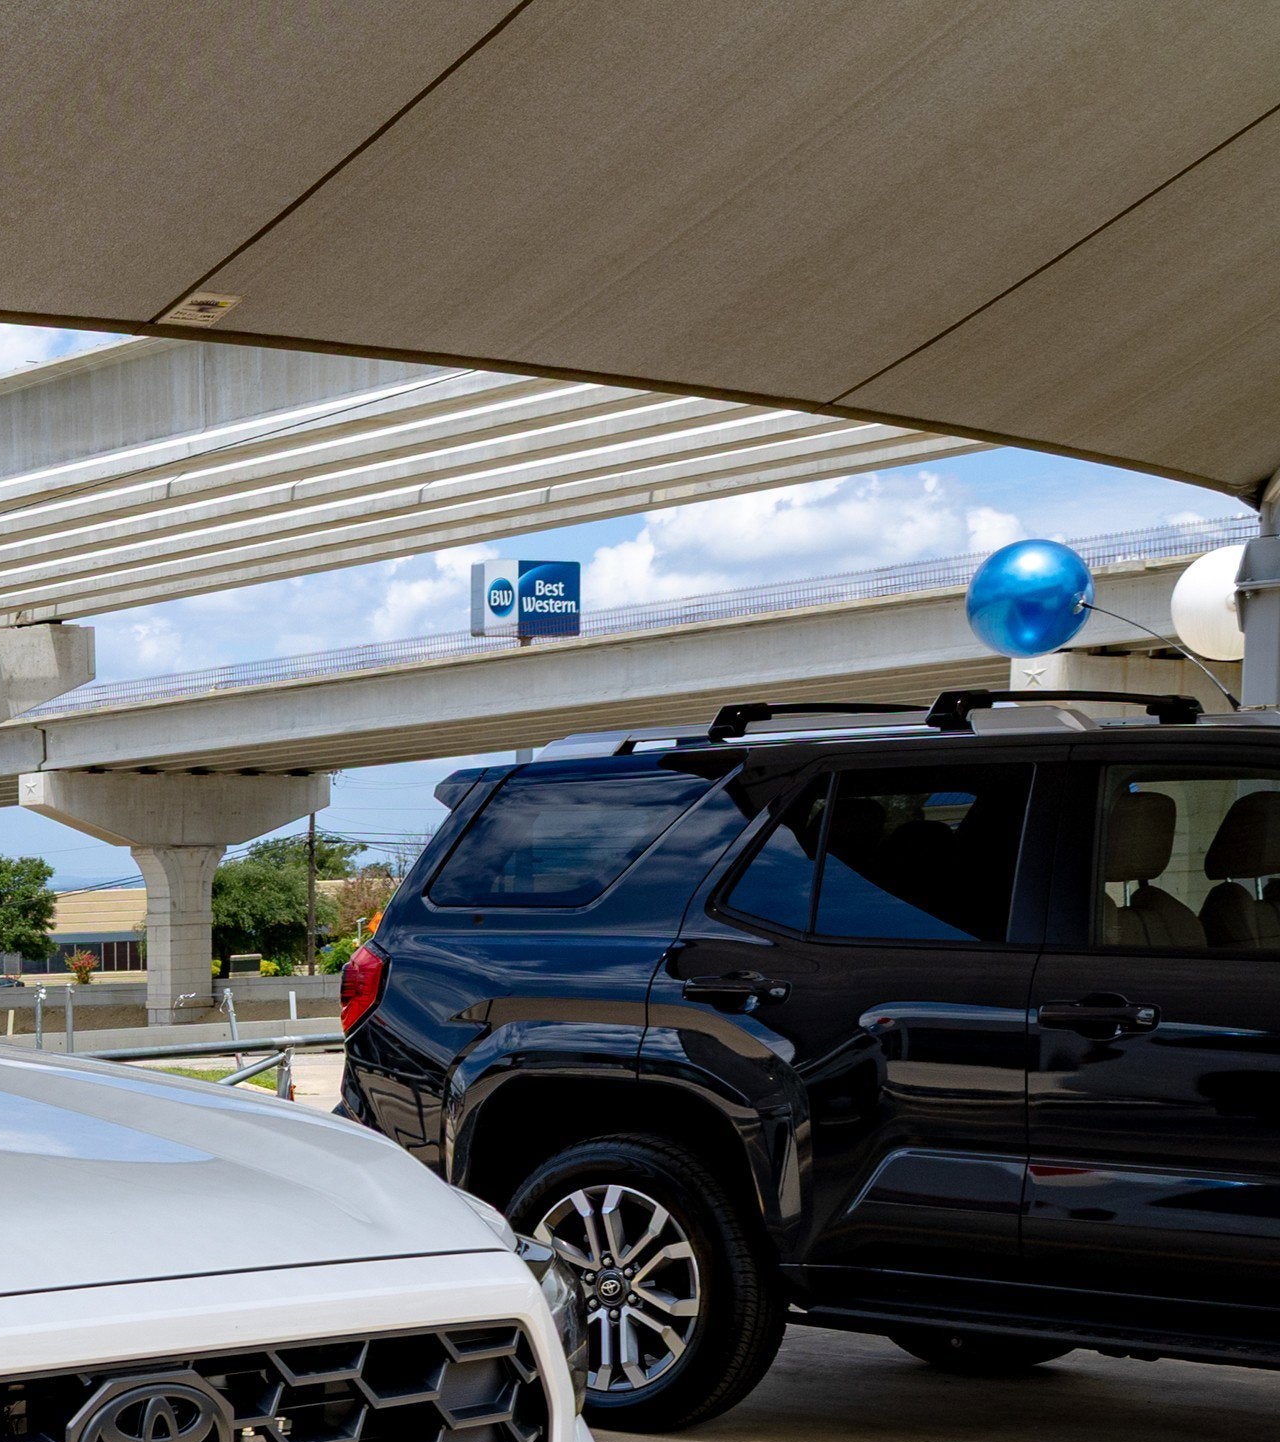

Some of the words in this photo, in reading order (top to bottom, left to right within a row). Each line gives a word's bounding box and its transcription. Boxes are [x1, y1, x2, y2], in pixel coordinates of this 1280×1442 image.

[535, 580, 565, 596] Best
[490, 590, 512, 606] BW
[522, 596, 576, 613] Western
